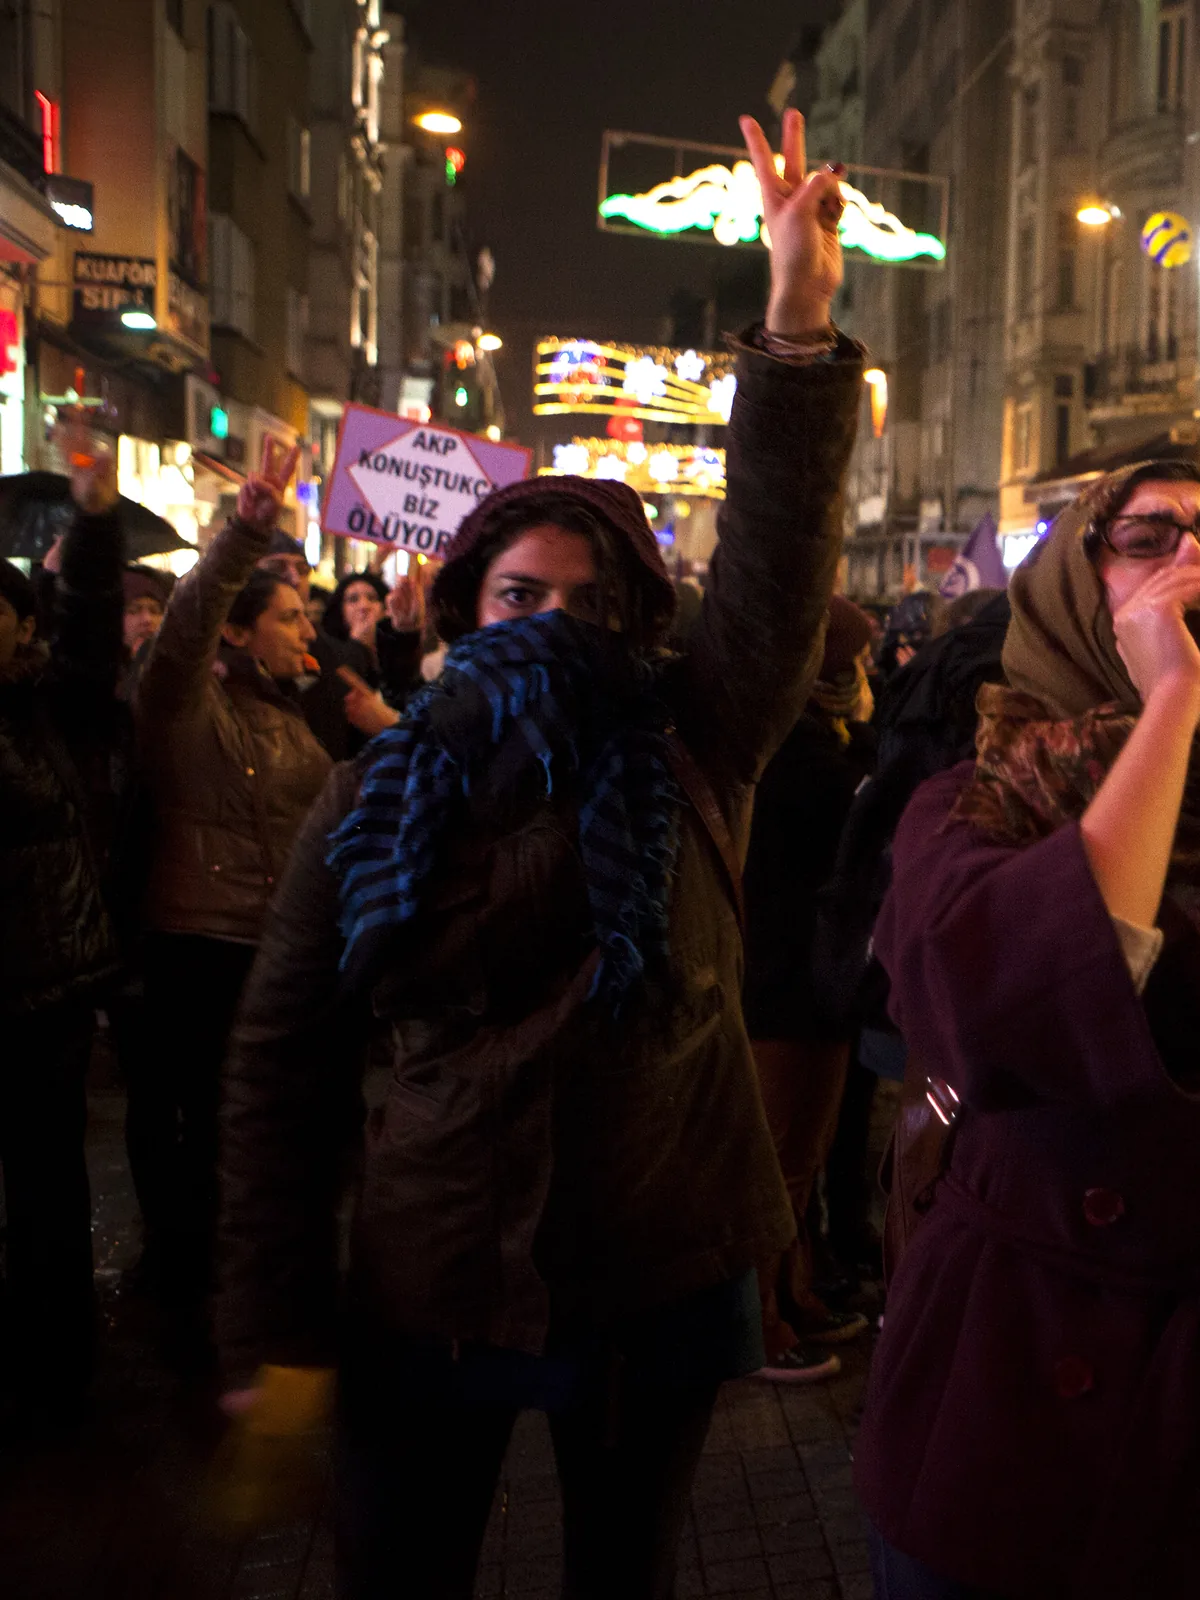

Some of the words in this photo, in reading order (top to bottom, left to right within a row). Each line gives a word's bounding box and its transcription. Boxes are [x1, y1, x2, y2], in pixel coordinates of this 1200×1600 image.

[412, 431, 457, 456] AKP
[358, 450, 499, 500] KONUŞTUKÇ
[403, 494, 440, 520] BİZ
